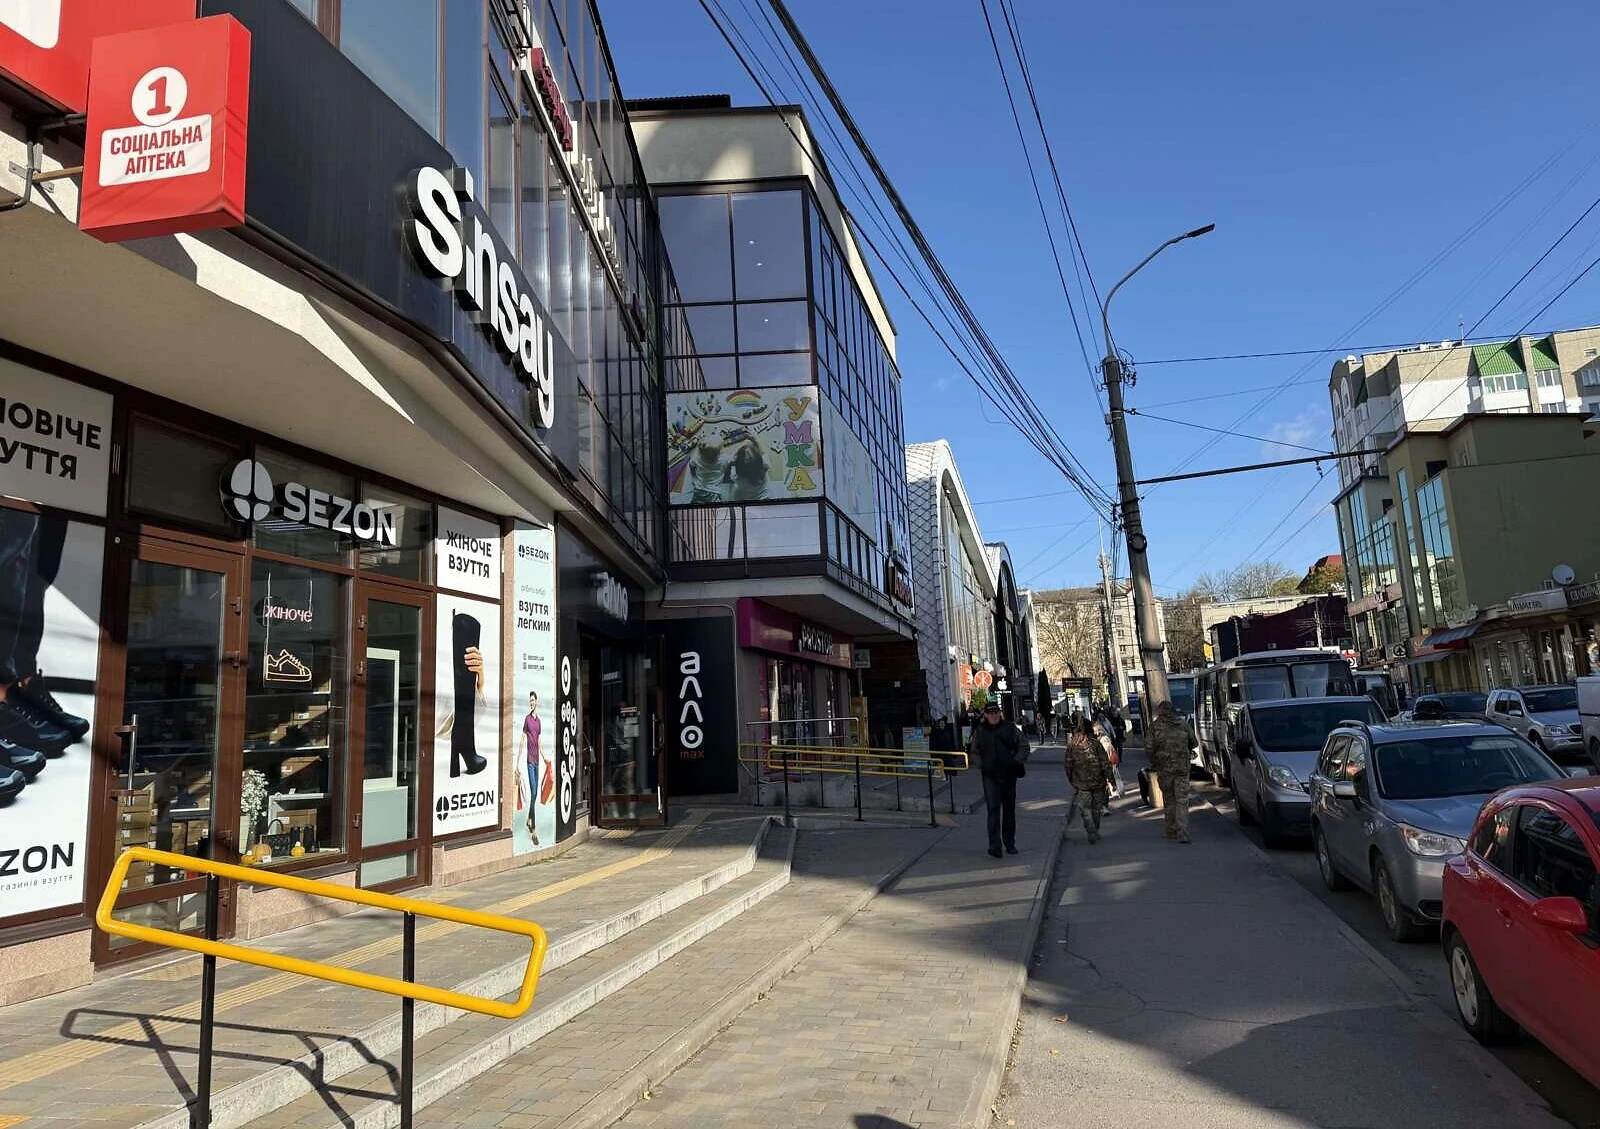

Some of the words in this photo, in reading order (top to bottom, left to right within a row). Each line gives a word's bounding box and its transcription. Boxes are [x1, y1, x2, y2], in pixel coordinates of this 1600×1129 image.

[146, 76, 172, 117] 1
[110, 124, 203, 156] СОЦІАЛЬНА
[124, 150, 187, 176] АПТЕКА
[0, 396, 102, 451] ОВІЧЕ
[783, 396, 817, 491] УМКА
[283, 482, 397, 546] SEZON
[446, 529, 493, 558] ЖІНОЧЕ
[525, 545, 549, 561] SEZON
[448, 553, 490, 579] ВЗУТТЯ
[517, 616, 551, 632] легким
[450, 790, 494, 811] SEZON
